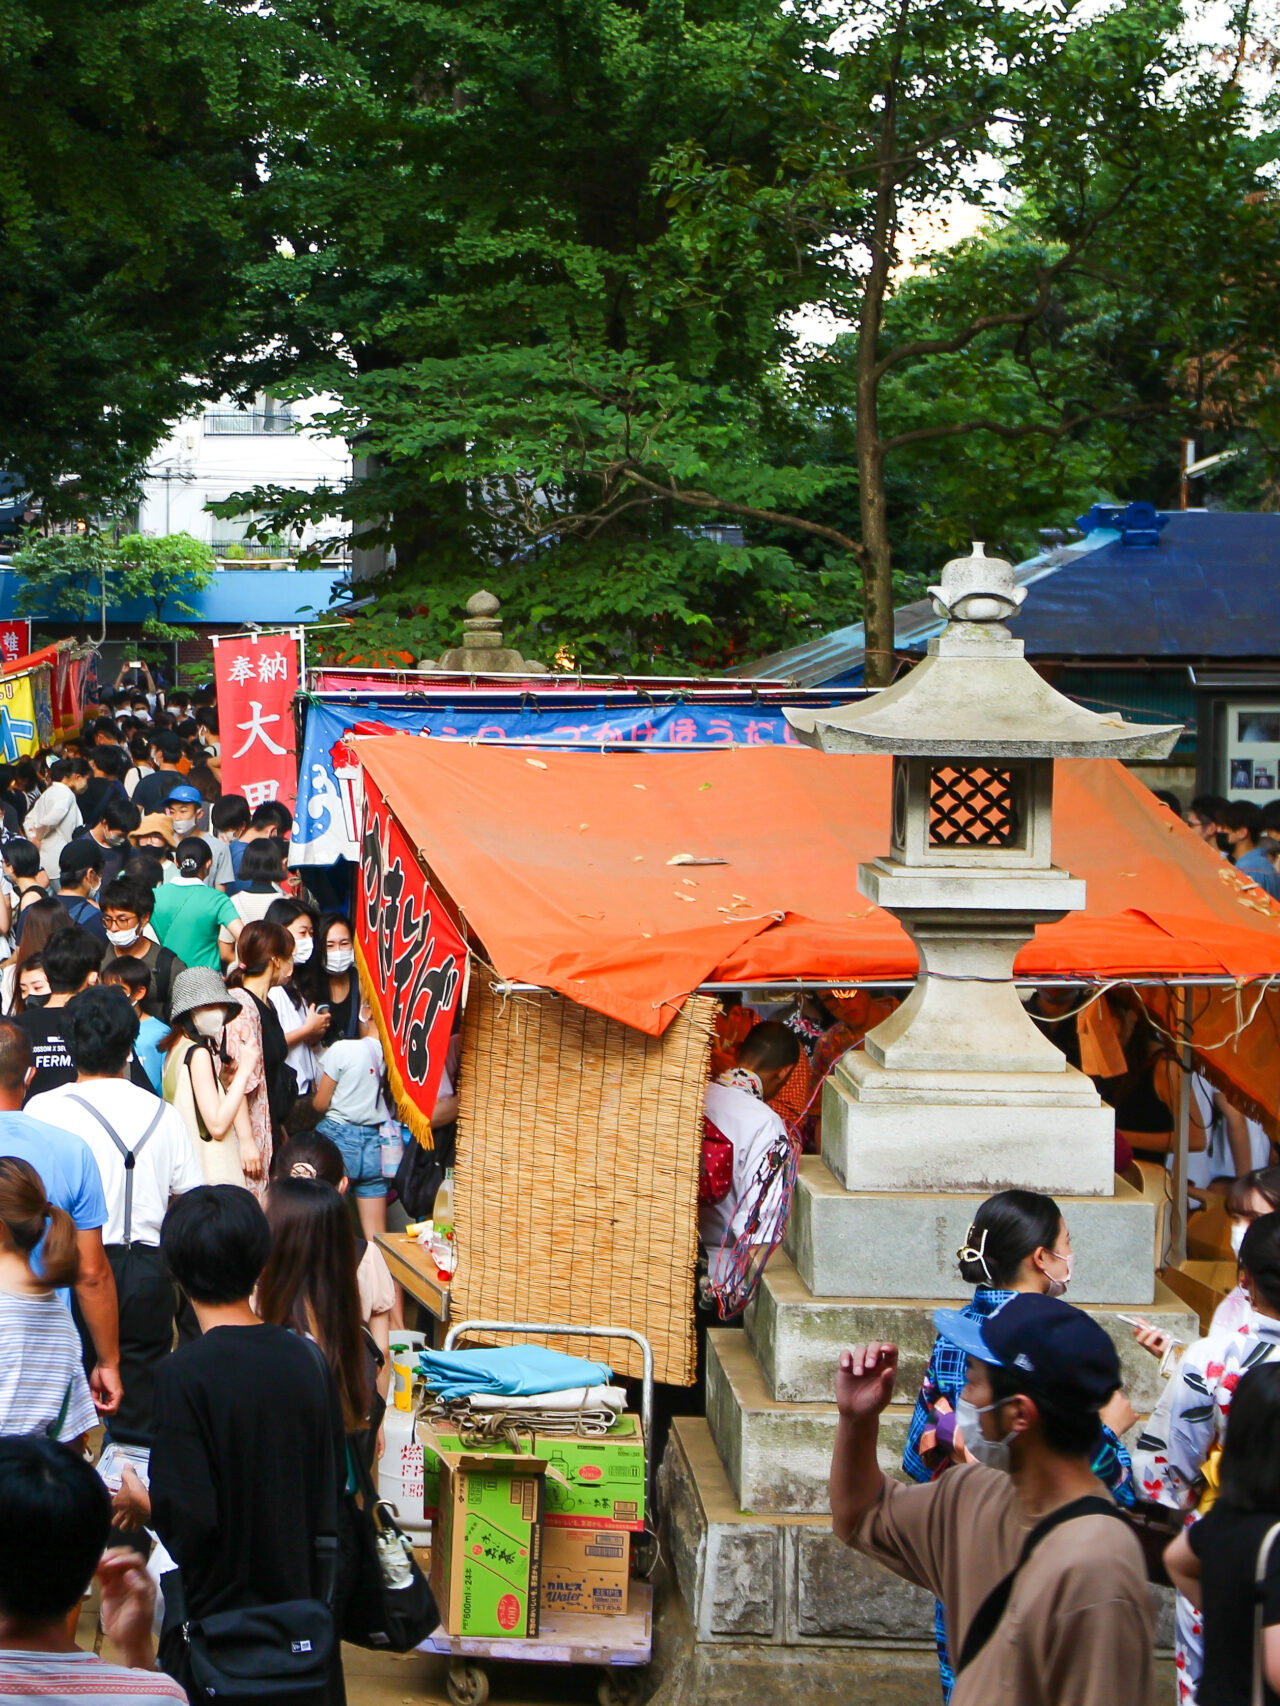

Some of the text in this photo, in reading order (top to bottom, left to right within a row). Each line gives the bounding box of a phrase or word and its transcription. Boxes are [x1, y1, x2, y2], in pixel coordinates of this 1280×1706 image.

[227, 651, 289, 687] 奉納
[361, 800, 460, 1087] やきそば
[35, 1054, 74, 1068] FERM
[547, 1582, 583, 1591] カルピス
[546, 1591, 583, 1602] Water
